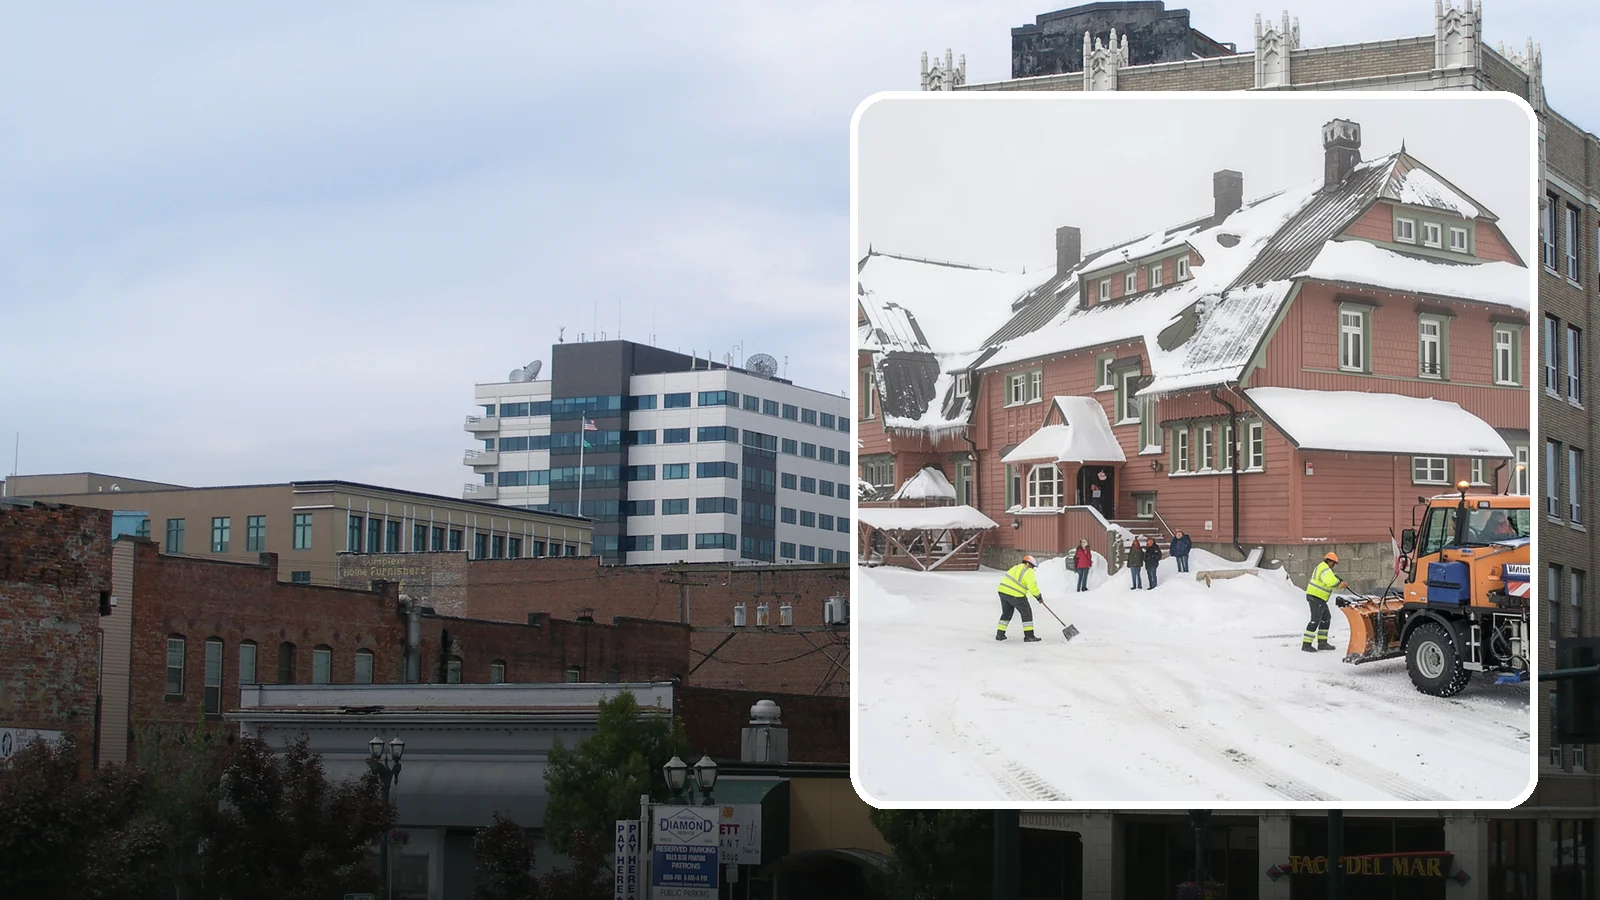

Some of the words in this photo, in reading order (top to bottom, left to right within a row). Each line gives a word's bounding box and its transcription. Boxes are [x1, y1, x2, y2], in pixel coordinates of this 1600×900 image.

[343, 567, 368, 577] Home
[370, 566, 427, 576] Furnishers
[660, 818, 713, 833] DIAMOND
[1022, 815, 1070, 828] BUILDING
[617, 825, 625, 853] PAY
[628, 824, 637, 853] PAY
[655, 845, 688, 853] RESERVED
[689, 846, 716, 854] PARKING
[671, 862, 701, 870] PATRONS
[1289, 855, 1330, 875] TAC
[1345, 856, 1385, 876] DEL
[1392, 857, 1442, 877] MAR
[616, 855, 625, 894] HERE
[627, 855, 636, 894] HERE
[660, 889, 682, 897] PUBLIC
[684, 890, 710, 898] PARKING
